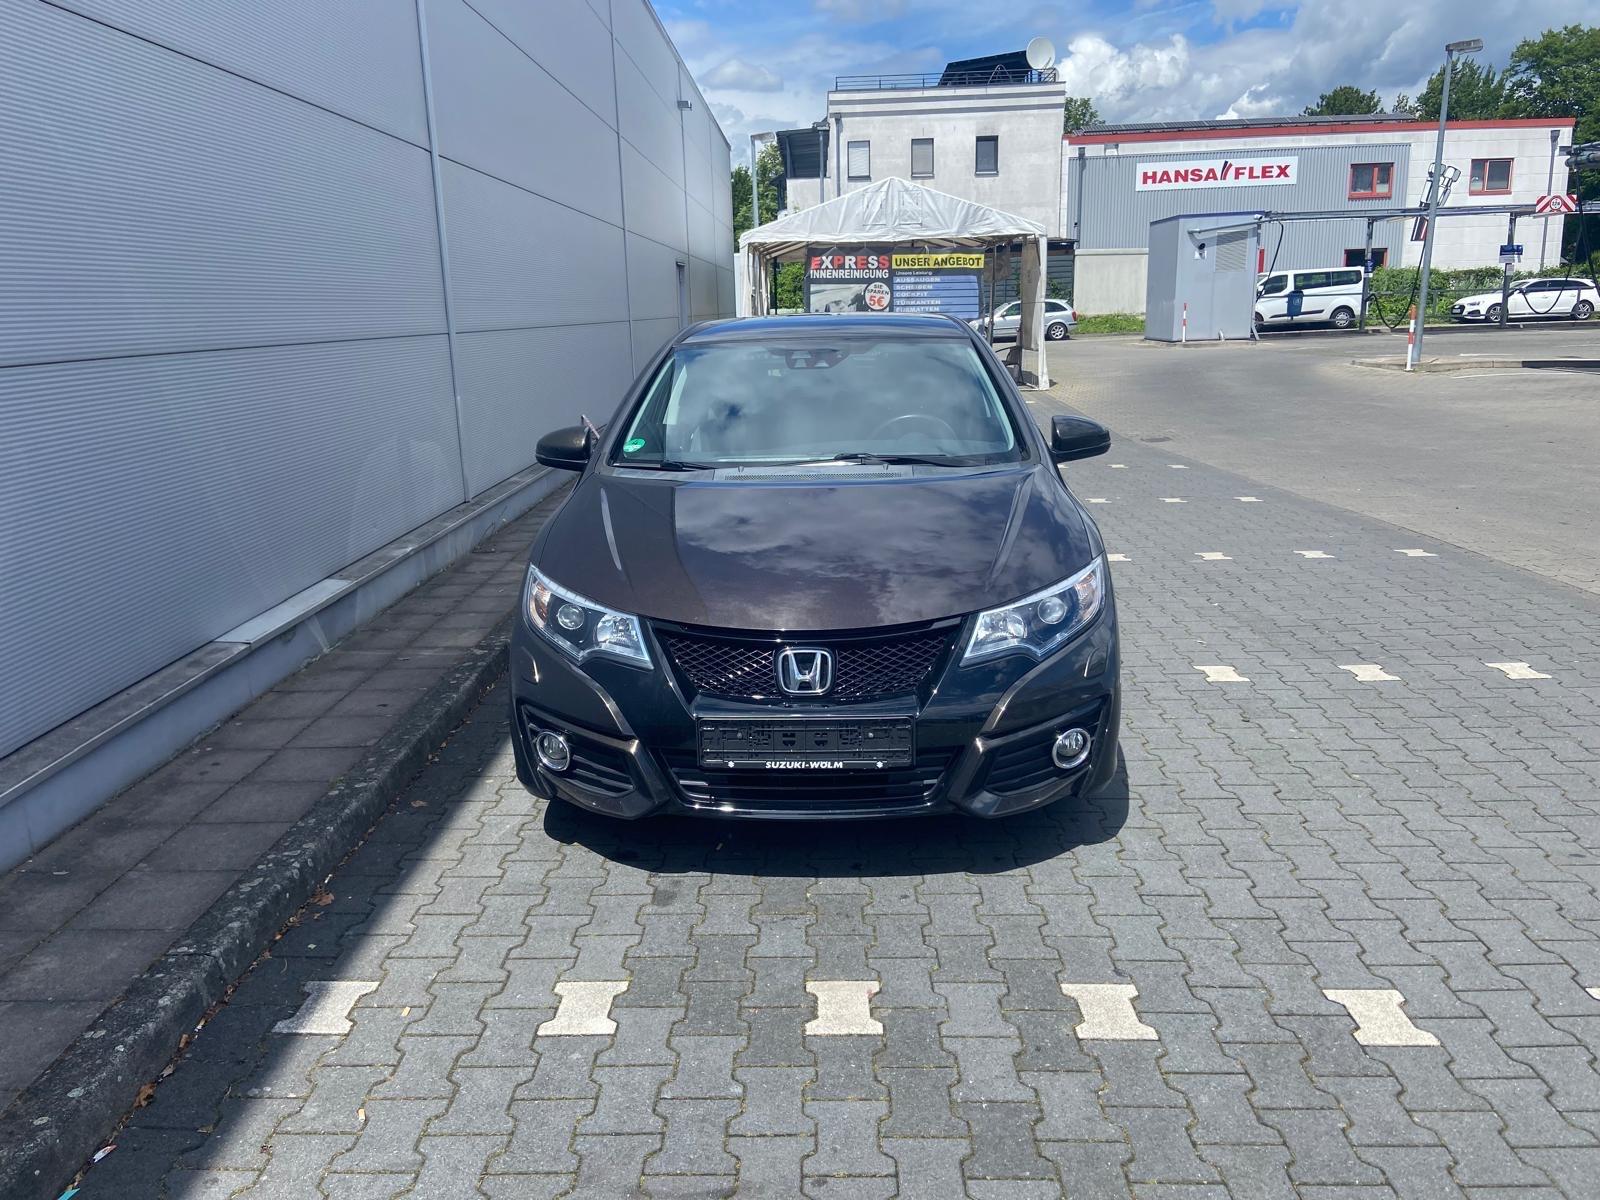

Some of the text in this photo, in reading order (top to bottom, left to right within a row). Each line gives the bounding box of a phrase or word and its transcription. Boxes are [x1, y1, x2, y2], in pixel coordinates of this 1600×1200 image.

[1142, 164, 1290, 184] HANSA FLEX
[811, 255, 889, 269] EXPRESS
[895, 256, 981, 266] UNSER ANGEBOT
[810, 269, 889, 279] INNENREINIGUNG
[869, 295, 885, 307] 5€
[765, 761, 843, 769] SUZUKI-WÖLM
